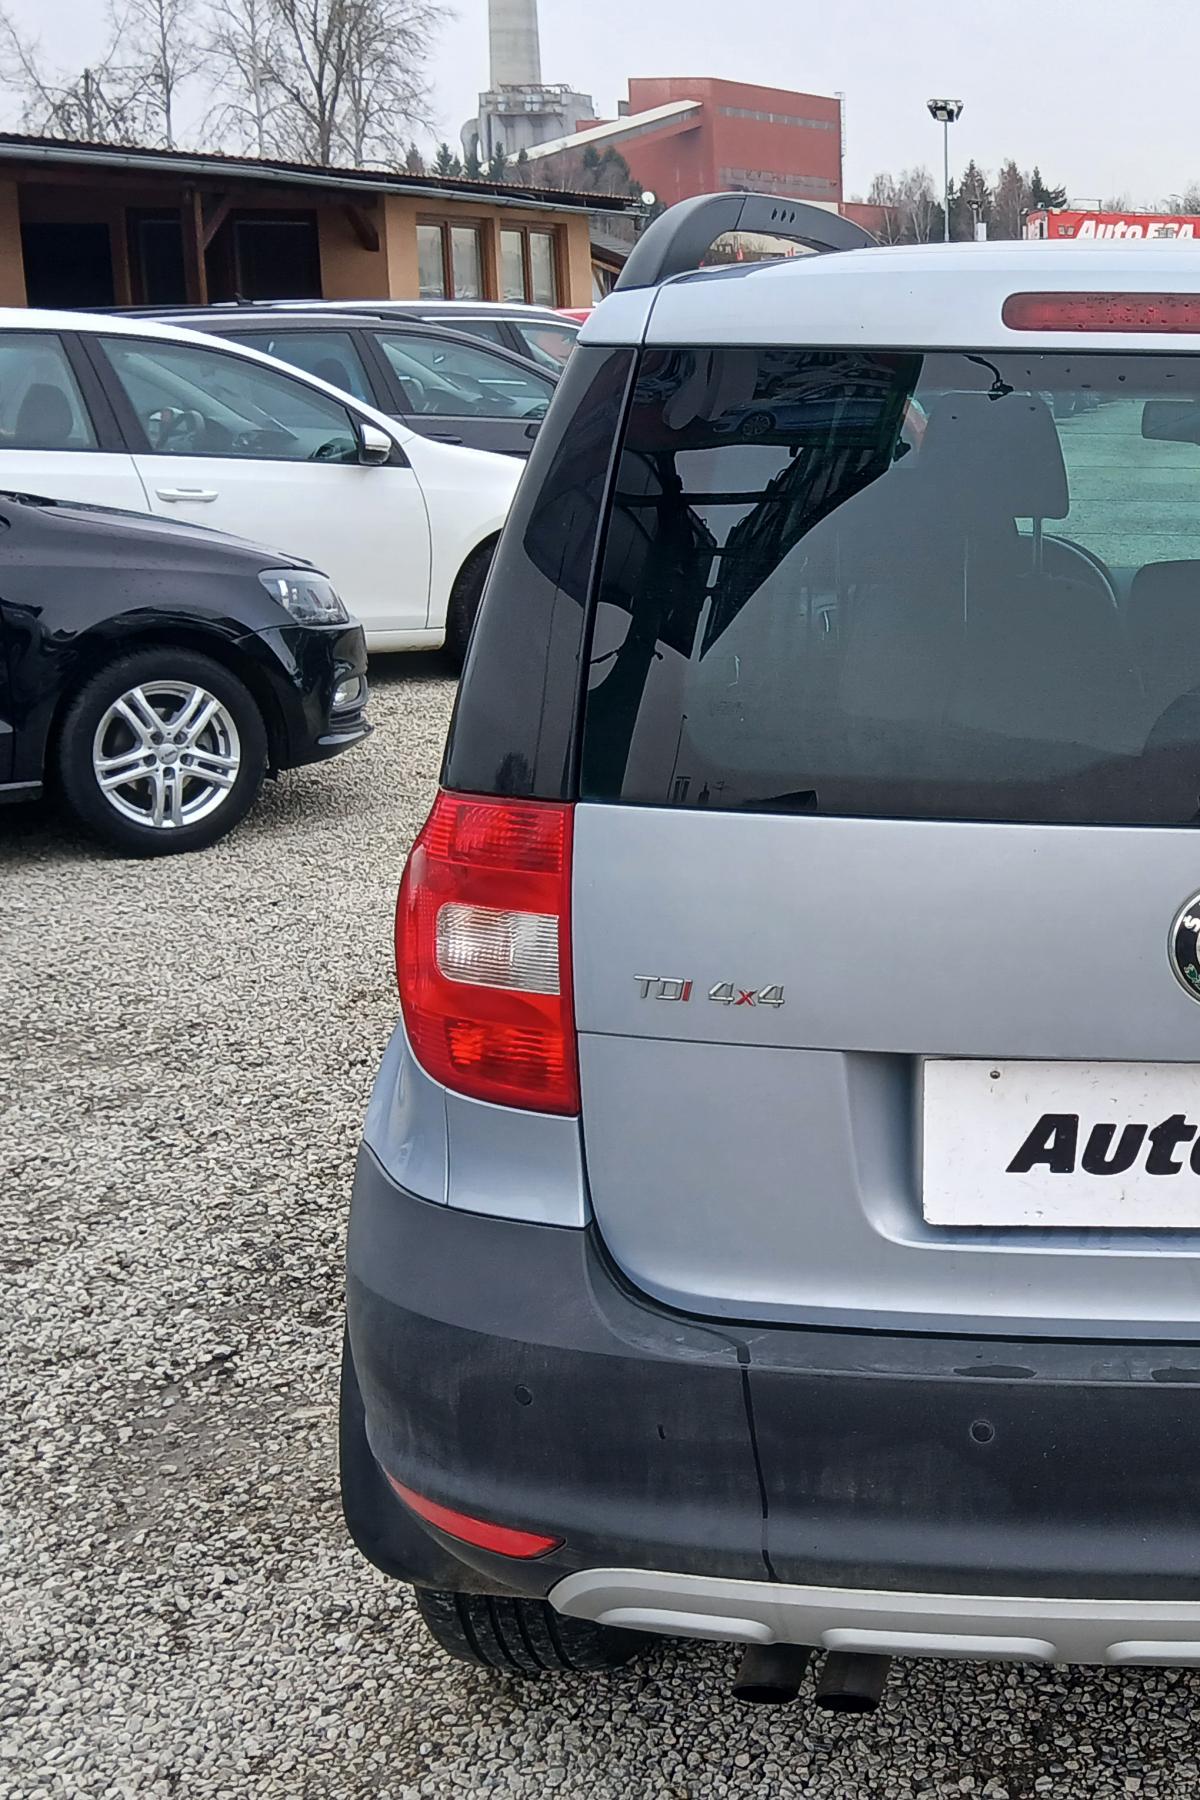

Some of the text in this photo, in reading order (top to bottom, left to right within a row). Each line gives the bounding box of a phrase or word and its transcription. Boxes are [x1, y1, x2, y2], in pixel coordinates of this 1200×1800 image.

[1075, 220, 1143, 240] Auto
[633, 973, 786, 1009] TDI 4x4
